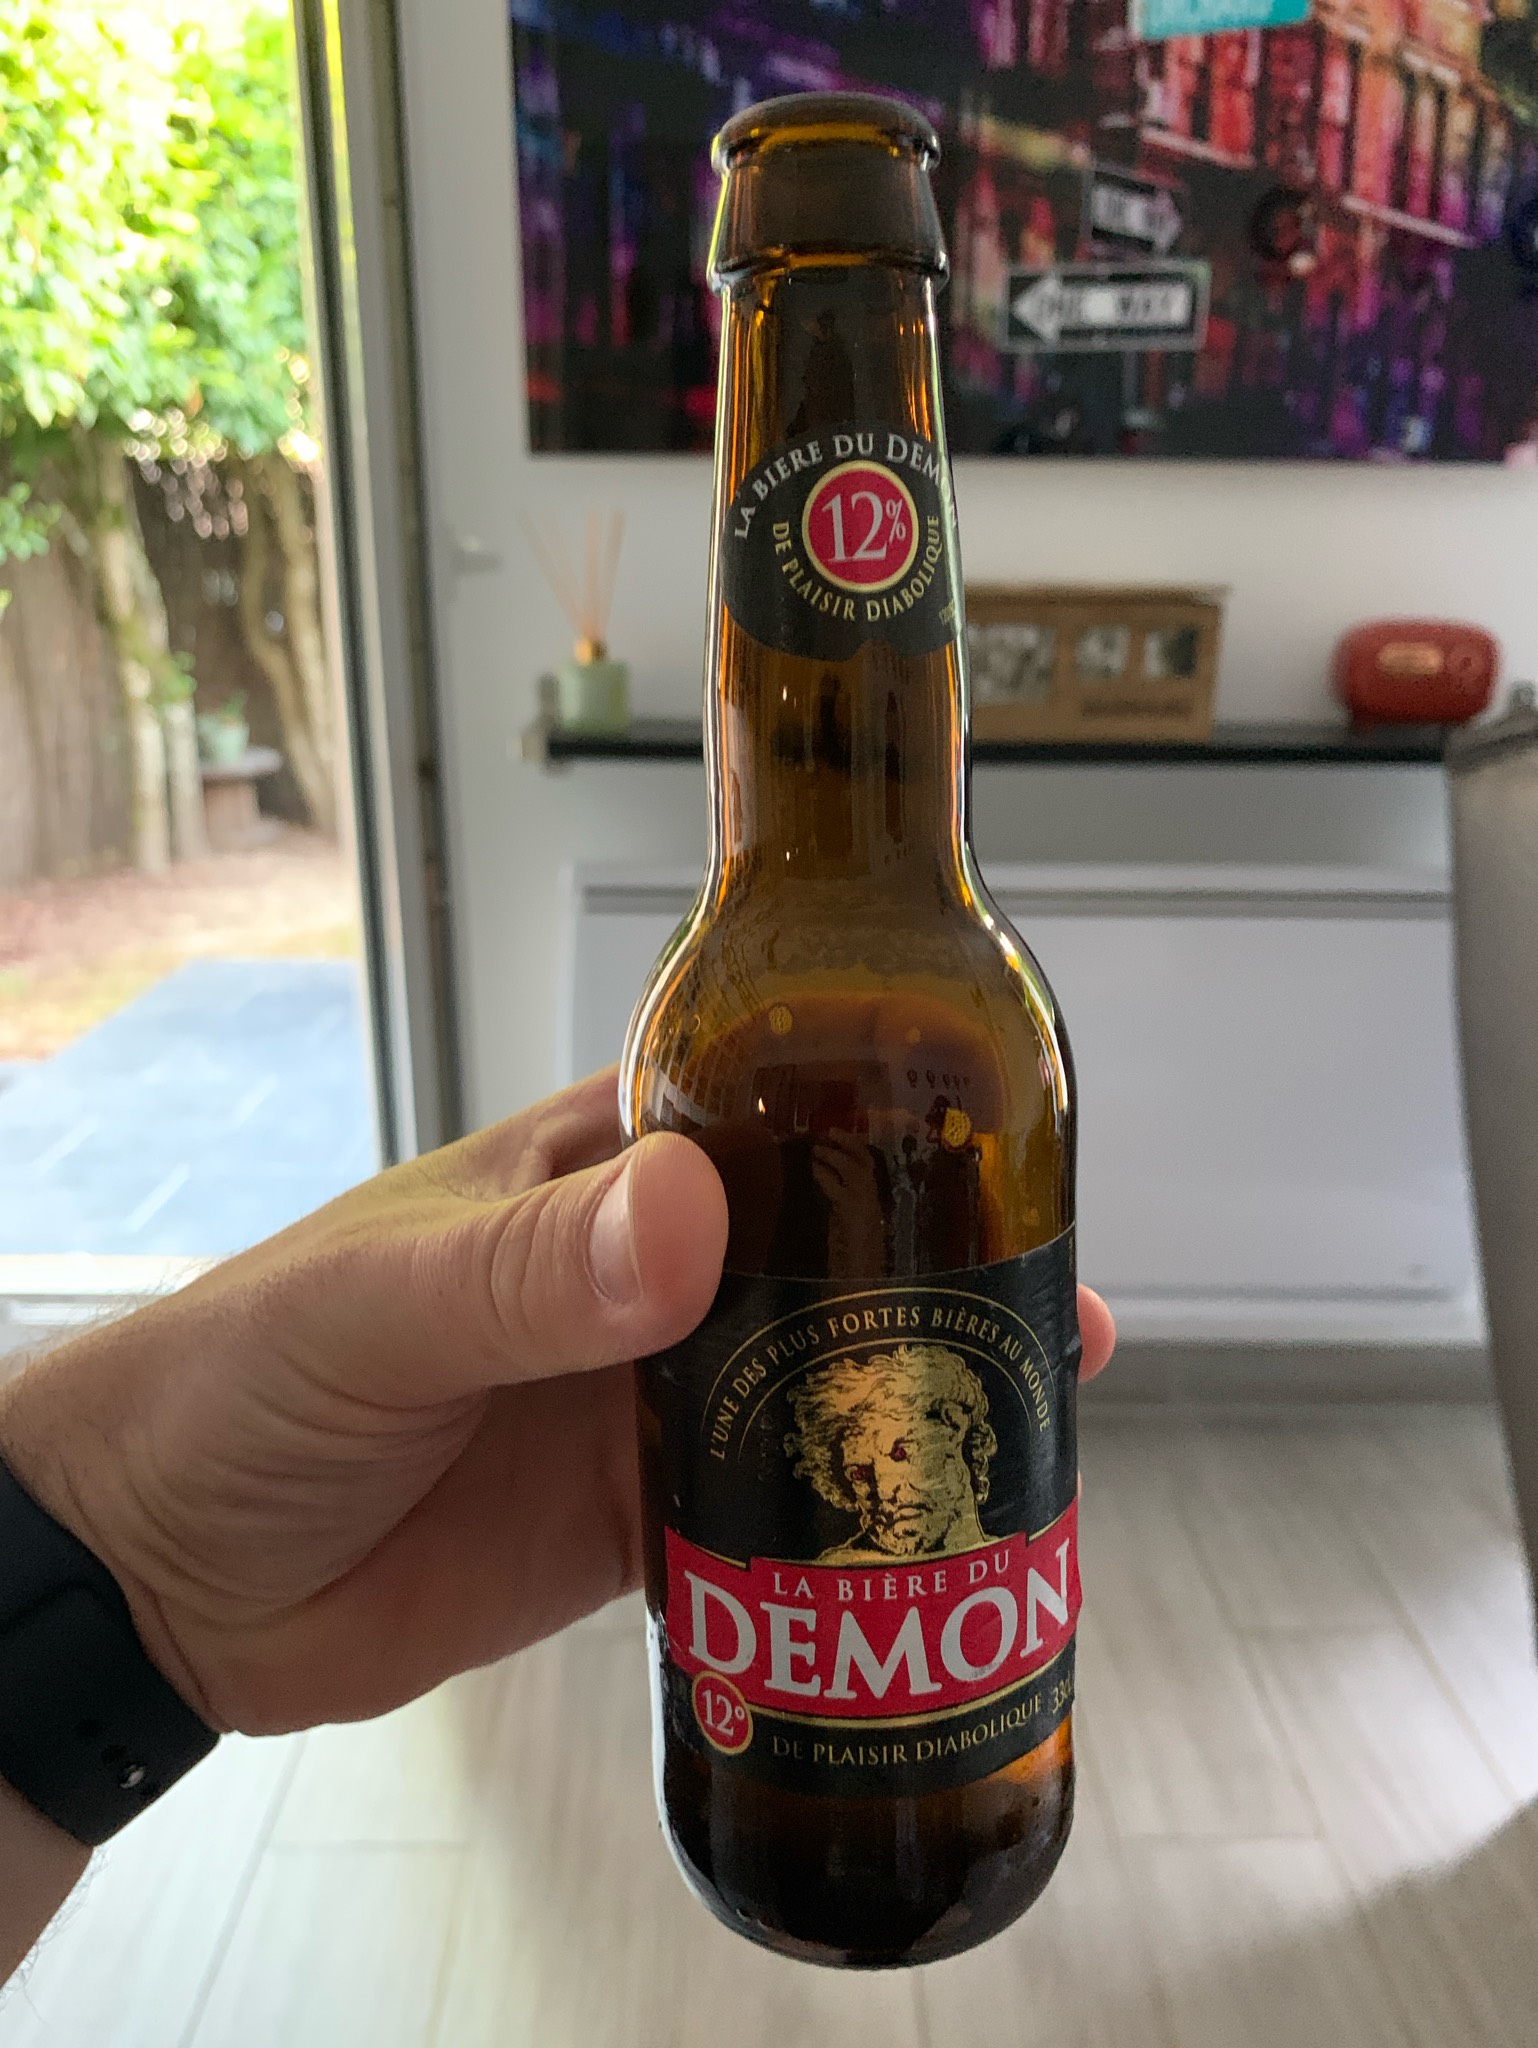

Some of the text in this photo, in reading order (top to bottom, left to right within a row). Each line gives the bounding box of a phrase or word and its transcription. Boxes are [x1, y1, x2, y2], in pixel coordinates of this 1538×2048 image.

[735, 504, 757, 539] LA
[833, 433, 874, 458] DU
[822, 490, 907, 563] 12%
[772, 515, 943, 622] DE PLAISIR DIABOLIQUE
[710, 1304, 1052, 1460] L'UNE DES PLUS FORTES BIÈRES AU MONDE
[684, 1538, 1071, 1700] DEMON
[773, 1549, 1010, 1602] LA BIÈRE DU
[772, 1735, 804, 1761] DE
[813, 1740, 909, 1766] PLAISIR
[916, 1694, 1043, 1764] DIABOLIQUE
